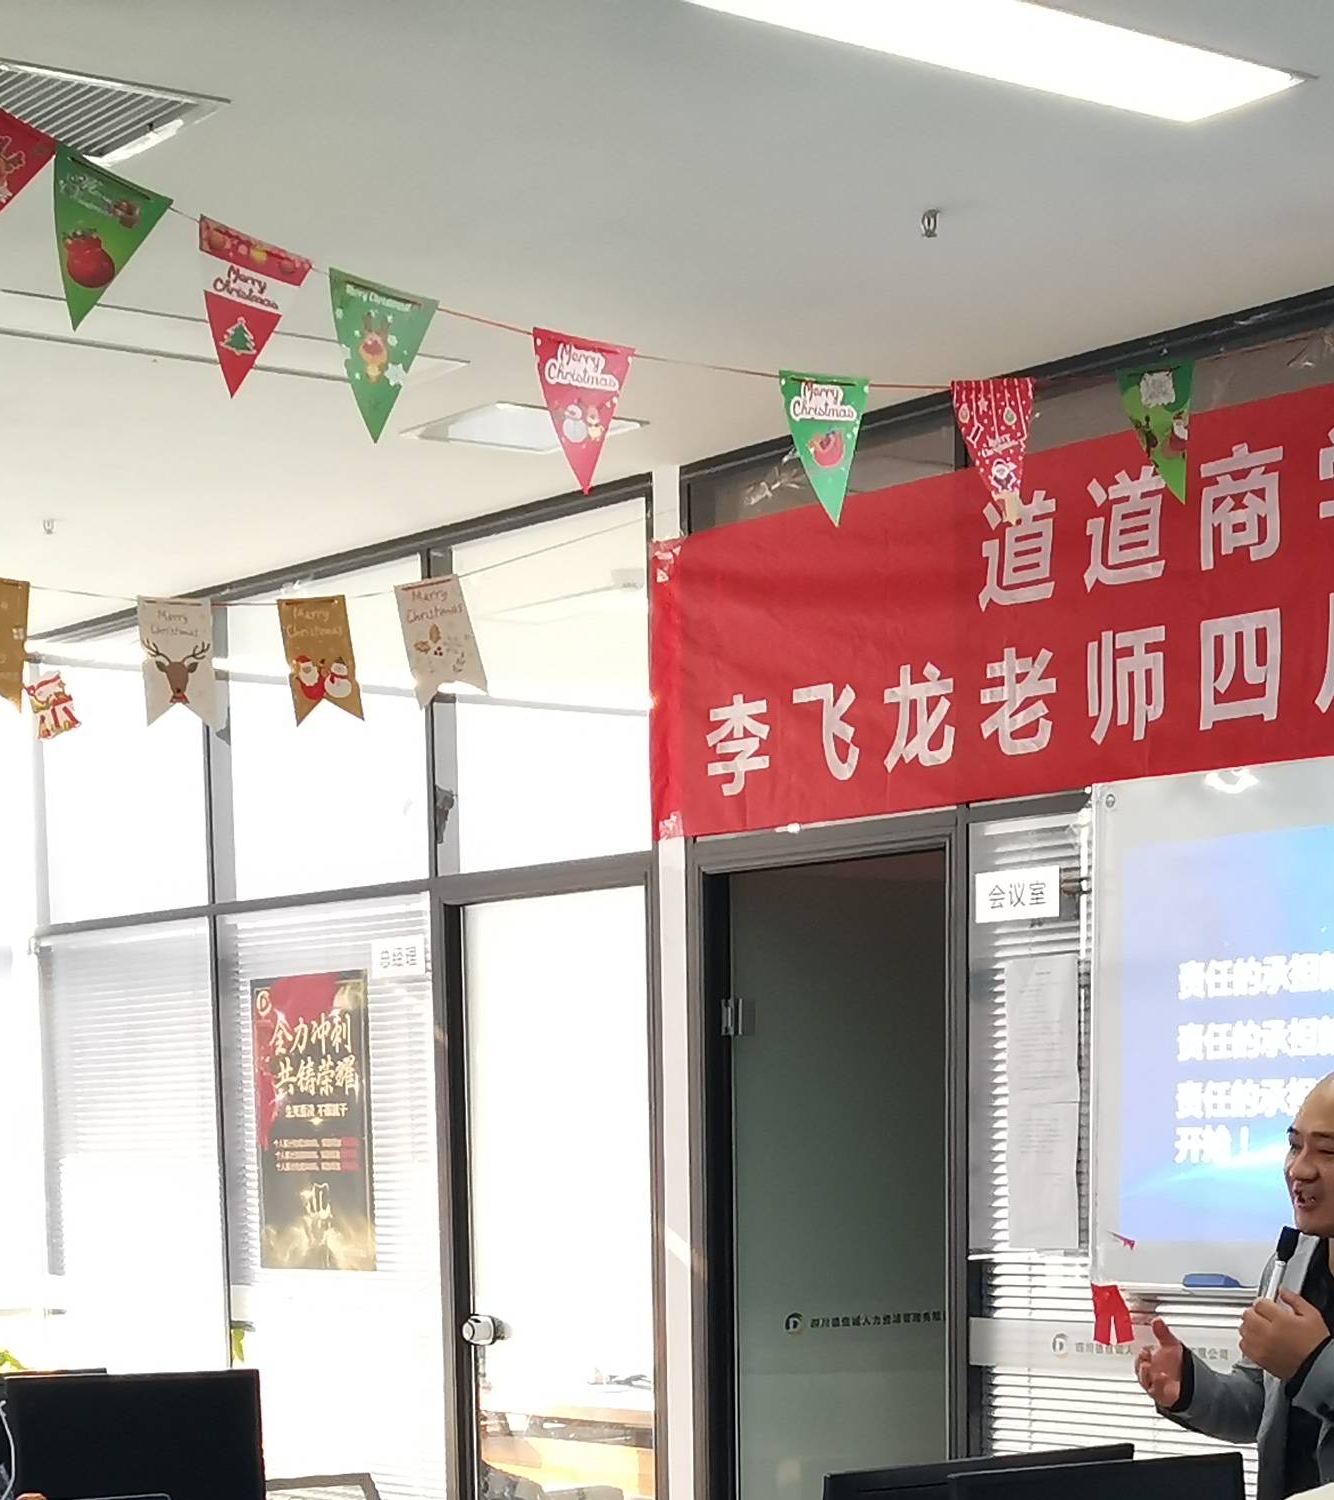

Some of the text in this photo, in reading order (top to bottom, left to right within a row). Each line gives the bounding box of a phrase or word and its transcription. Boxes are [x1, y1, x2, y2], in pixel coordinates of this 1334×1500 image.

[212, 276, 280, 310] Christmas
[226, 266, 267, 294] Merry
[561, 344, 601, 371] Merry
[548, 362, 618, 390] Christmas
[803, 382, 841, 403] Merry
[792, 399, 855, 420] Christmas
[411, 587, 448, 603] Merry
[293, 607, 330, 624] Merry
[989, 880, 1047, 909] 会议室
[269, 1012, 352, 1056] 全力冲刺
[1174, 1124, 1251, 1165] 开始！
[809, 1310, 945, 1329] 四川德信诚人力资源管理有限
